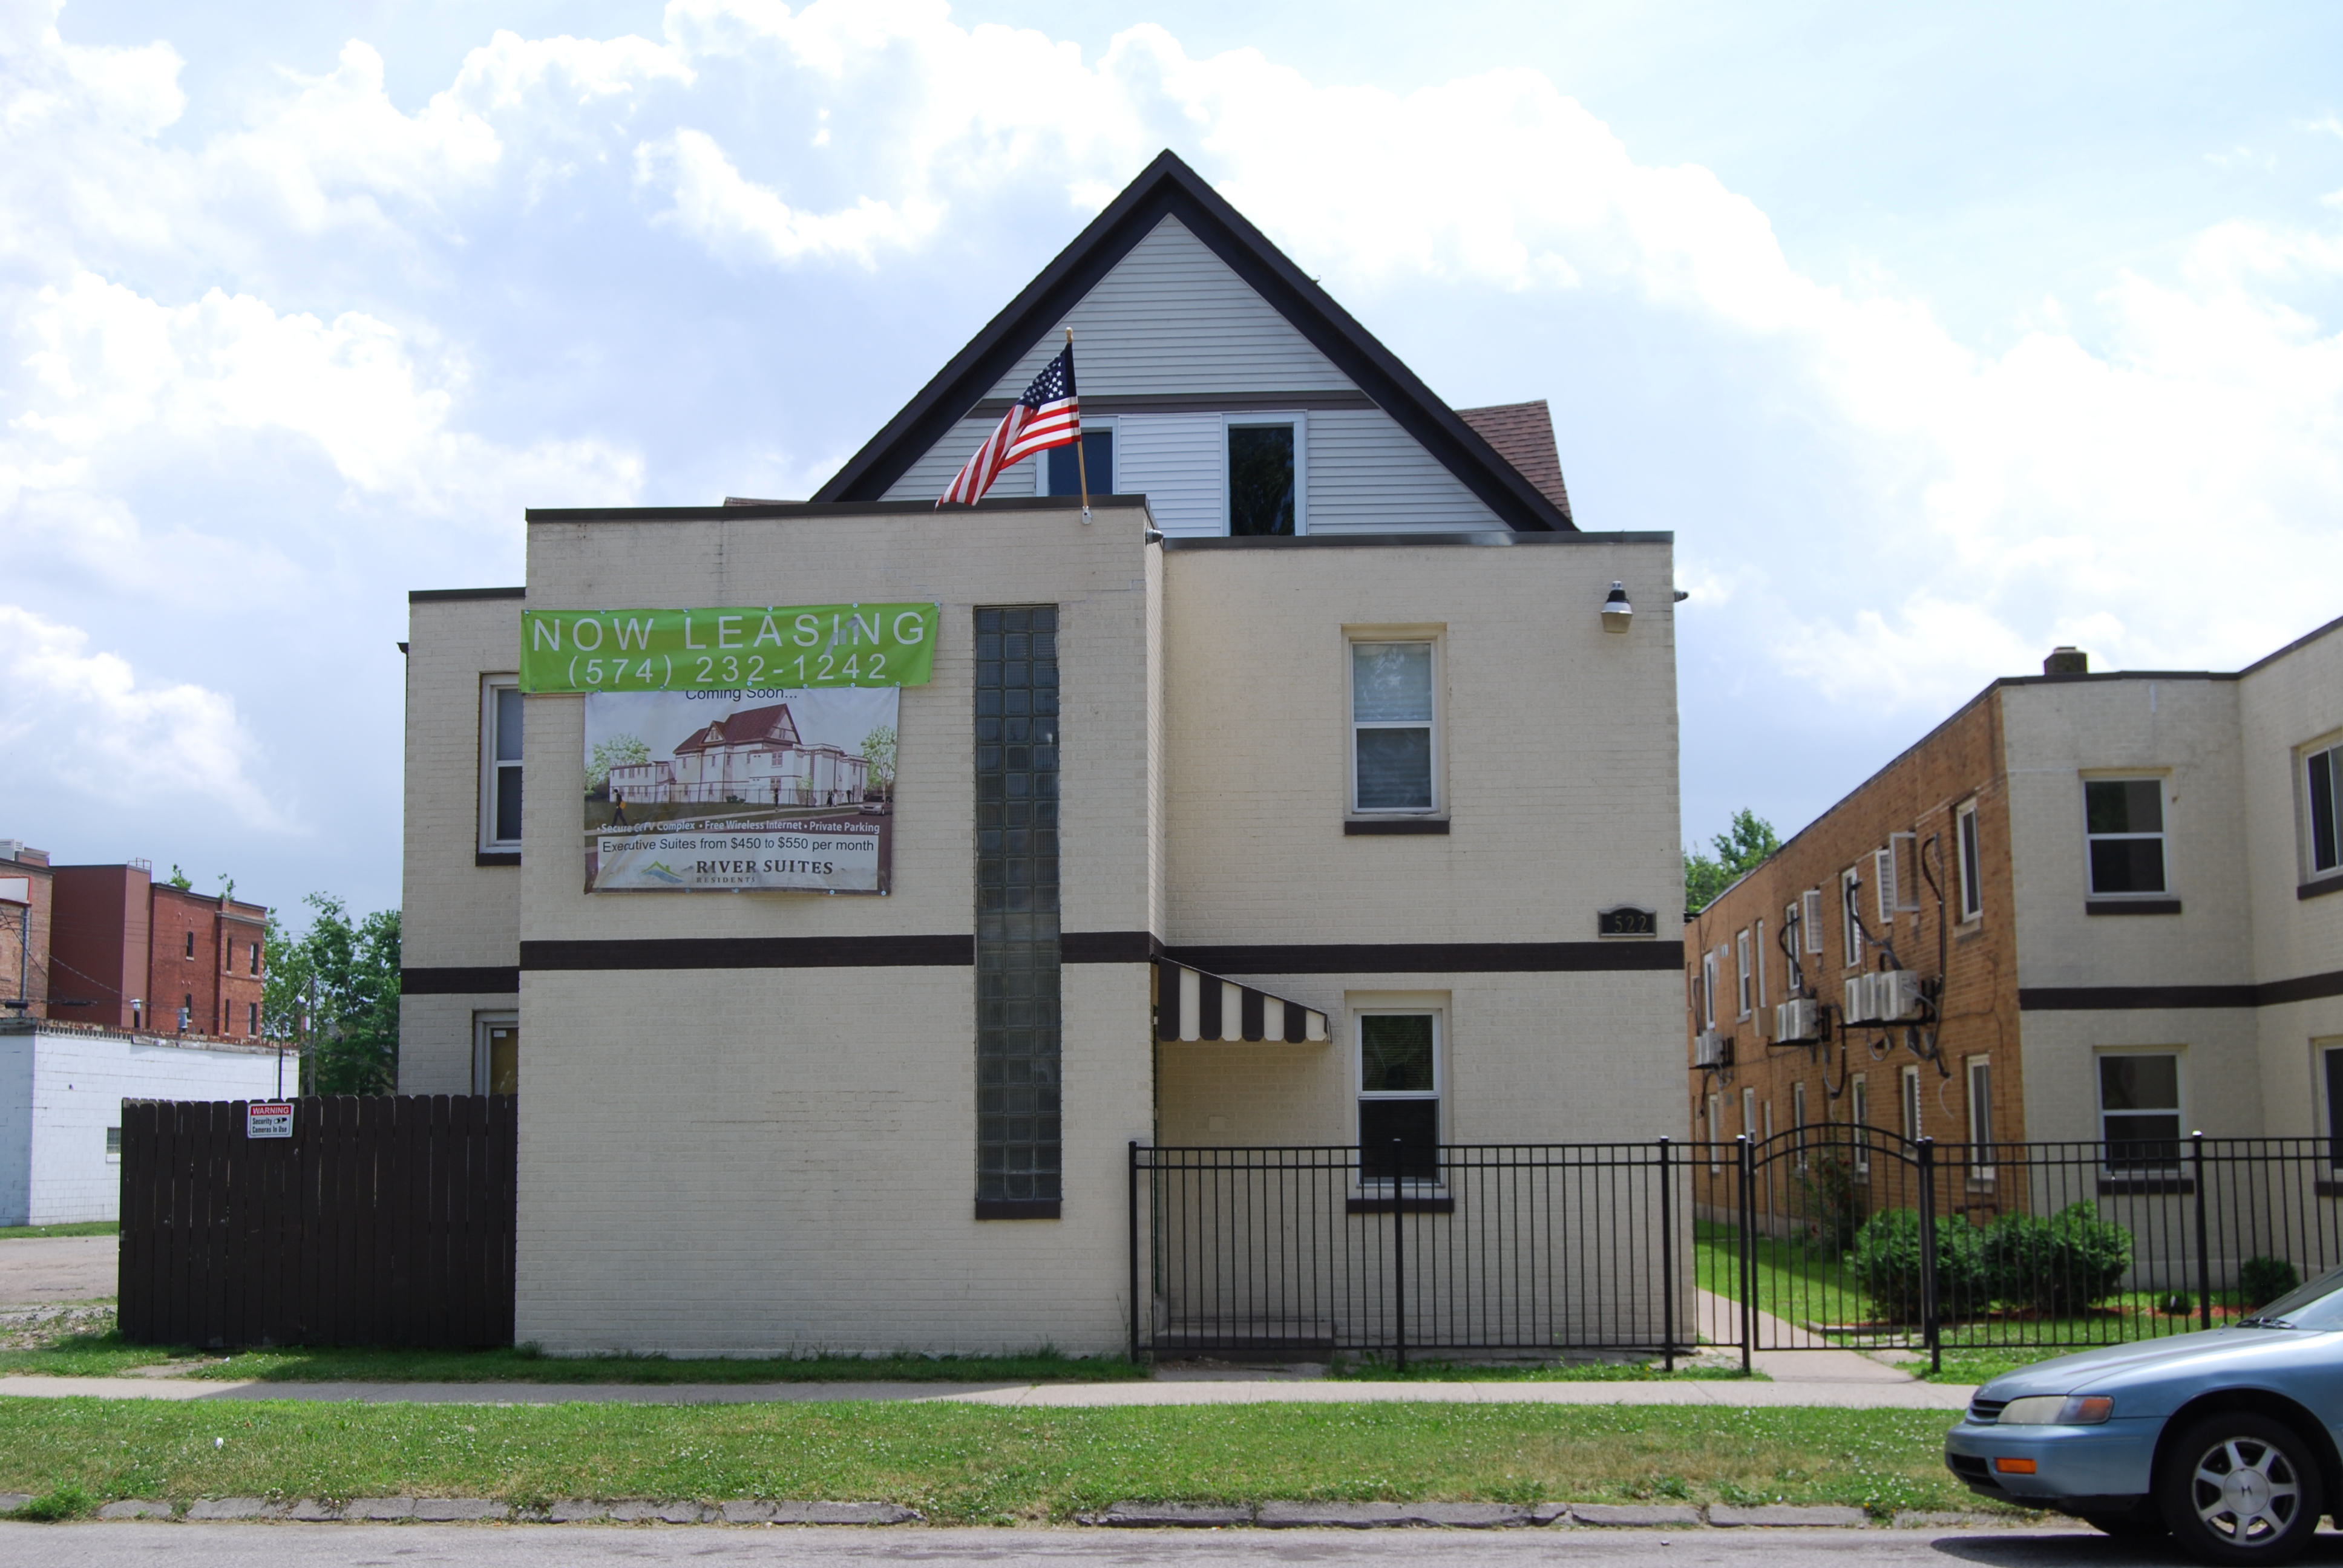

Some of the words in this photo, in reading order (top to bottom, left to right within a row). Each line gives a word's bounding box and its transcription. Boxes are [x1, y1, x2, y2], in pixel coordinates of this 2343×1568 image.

[534, 618, 654, 652] NOW
[685, 612, 923, 650] LEASING
[569, 654, 672, 688] (574)
[696, 653, 886, 682] 232-1242
[686, 689, 741, 702] Coming
[601, 823, 632, 833] Secure
[657, 821, 695, 832] Complex
[704, 820, 724, 830] Free
[726, 820, 764, 830] Wireless
[767, 820, 802, 830] Internet
[810, 821, 842, 832] Private
[844, 822, 880, 834] Parking
[603, 840, 656, 852] Executive
[660, 838, 696, 849] Suites
[700, 838, 727, 849] from
[730, 837, 761, 849] $450
[765, 838, 775, 849] to
[778, 836, 808, 849] $550
[812, 840, 832, 852] per
[836, 840, 874, 851] month
[696, 860, 756, 874] RIVER
[763, 860, 833, 875] SUITES
[1614, 915, 1647, 932] 522
